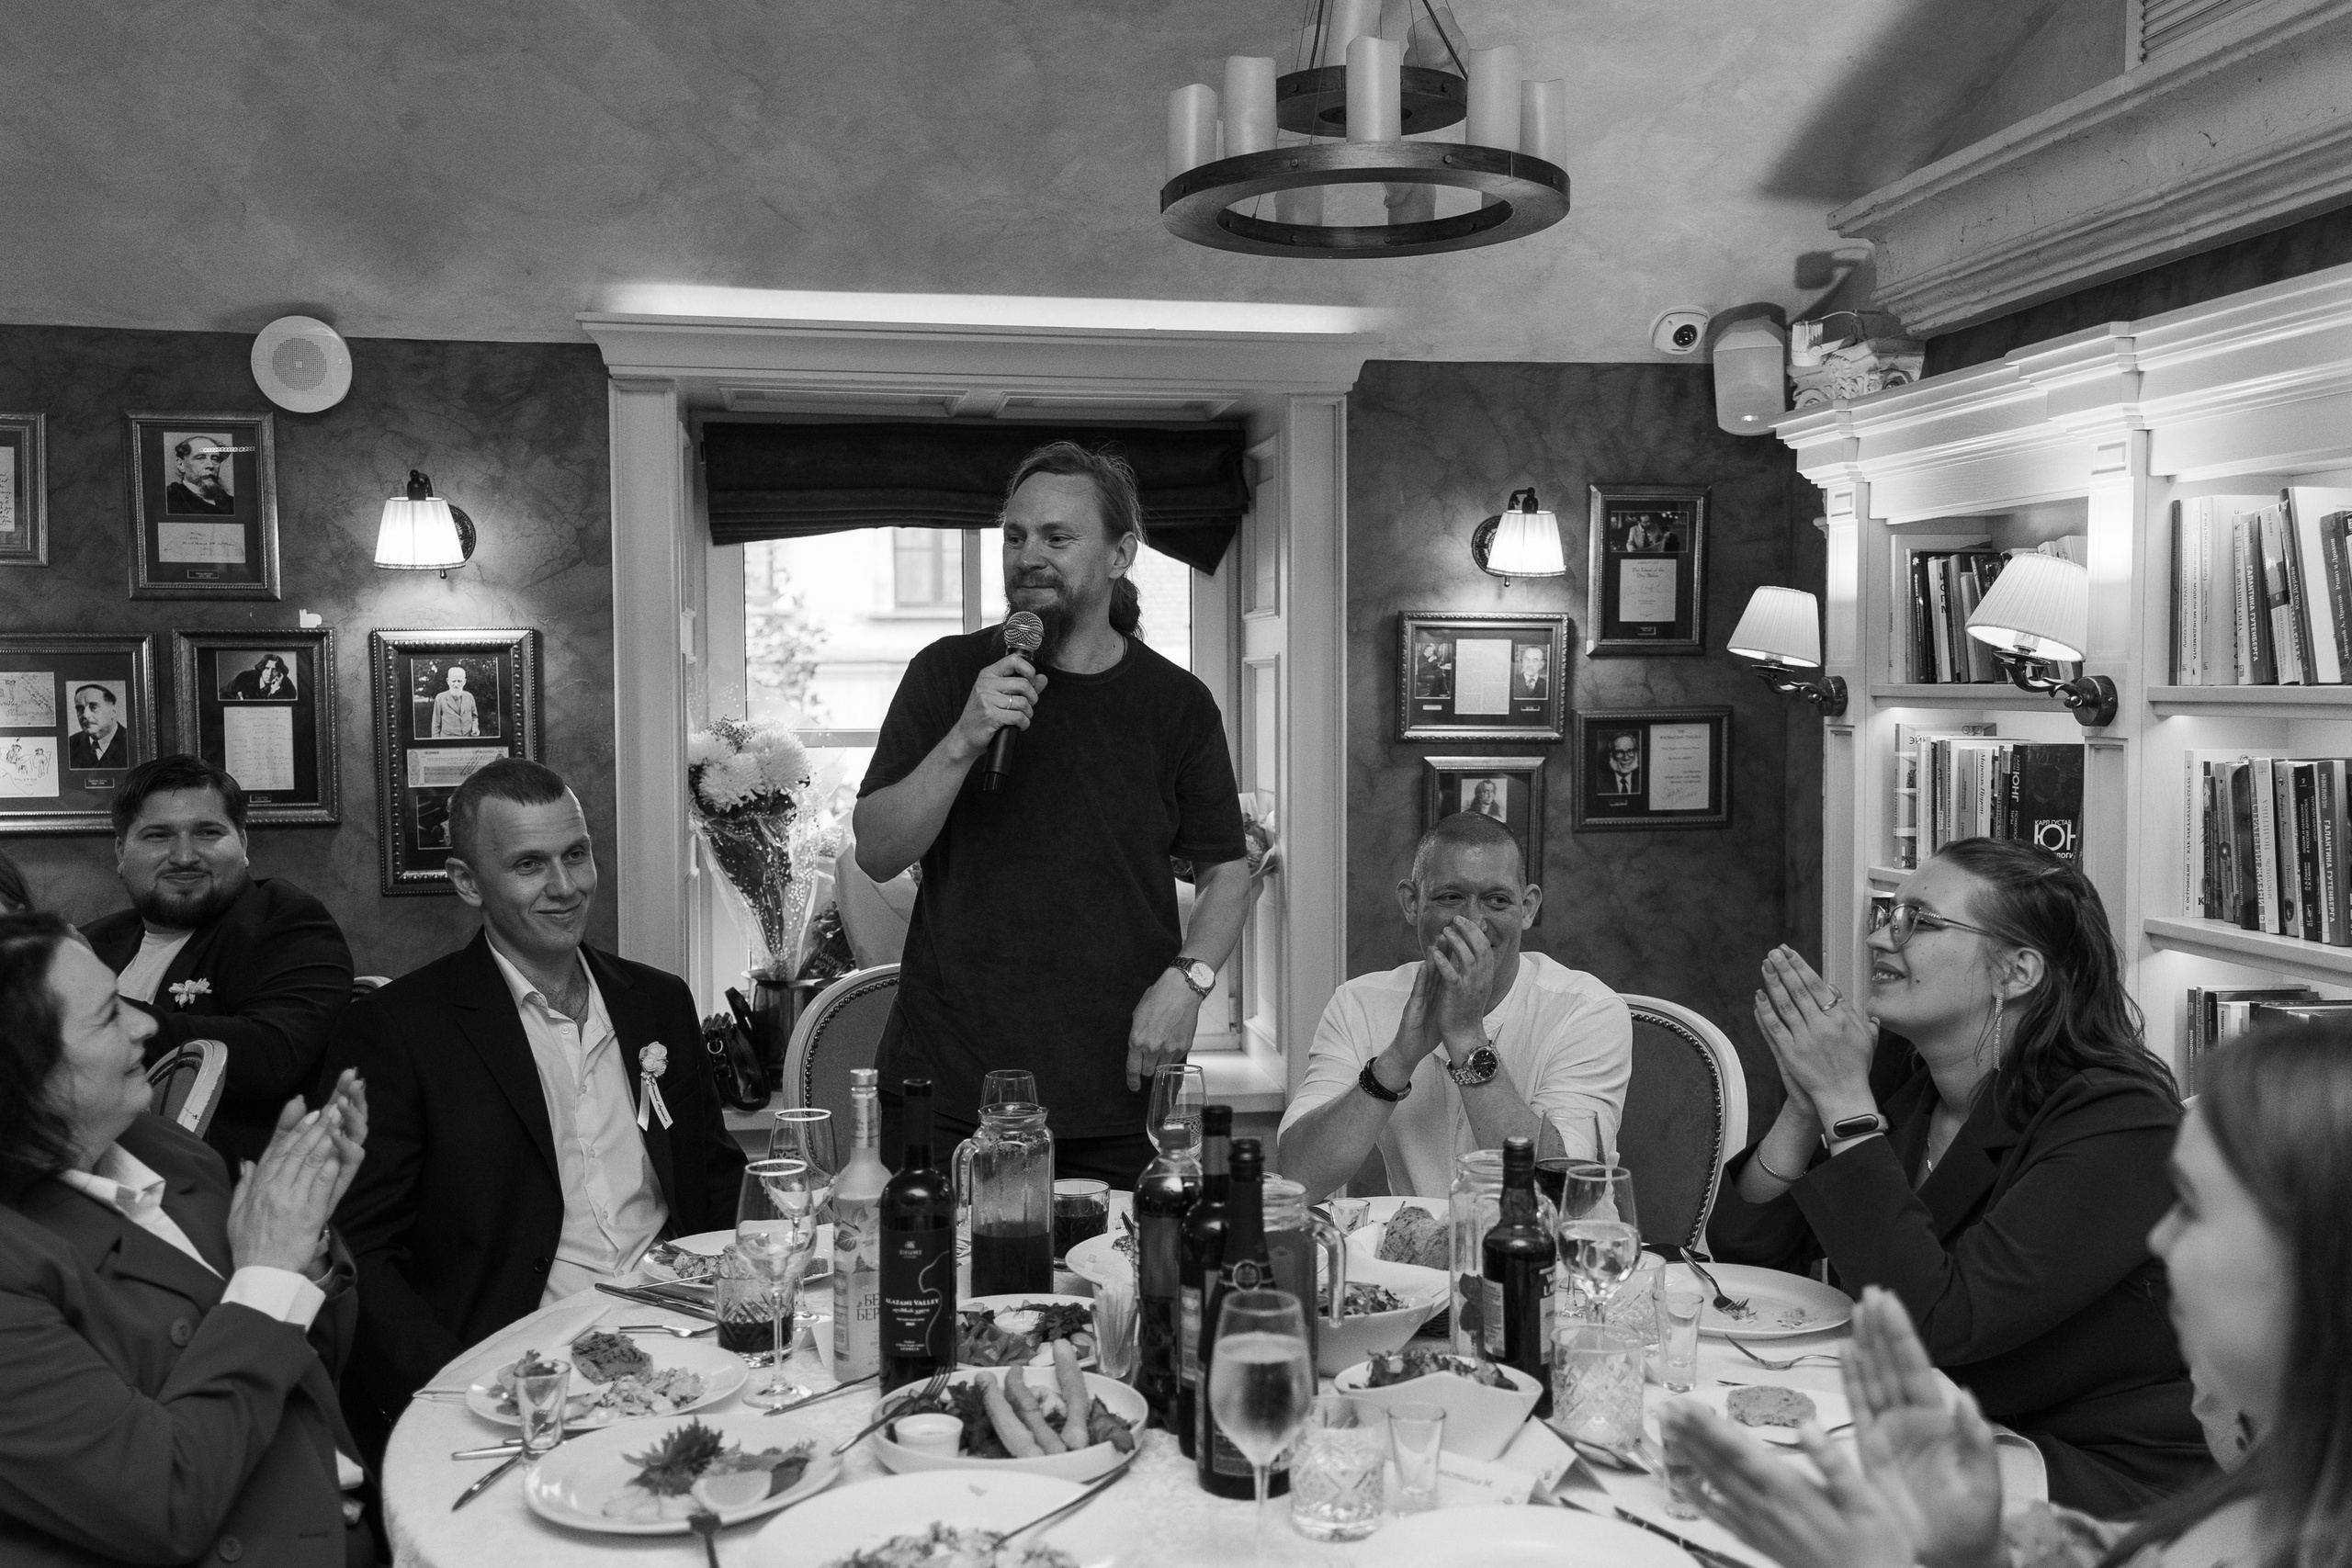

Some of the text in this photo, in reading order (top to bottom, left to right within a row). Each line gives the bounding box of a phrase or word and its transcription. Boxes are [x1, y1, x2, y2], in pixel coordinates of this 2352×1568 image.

[2331, 537, 2339, 563] Дракон
[2290, 566, 2300, 593] Дурова
[2246, 565, 2258, 661] ГАЛАКТИКА ГУТЕНБЕРГА
[2342, 629, 2350, 660] Дмитрий
[2011, 772, 2020, 802] ЮНГ
[2261, 798, 2270, 851] ПОЛИТИКА
[2256, 865, 2266, 907] ЖИЗНИ
[2324, 819, 2335, 923] ГАЛАКТИКА ГУТЕНБЕРГА
[885, 1297, 939, 1306] ALAZANI VALLEY
